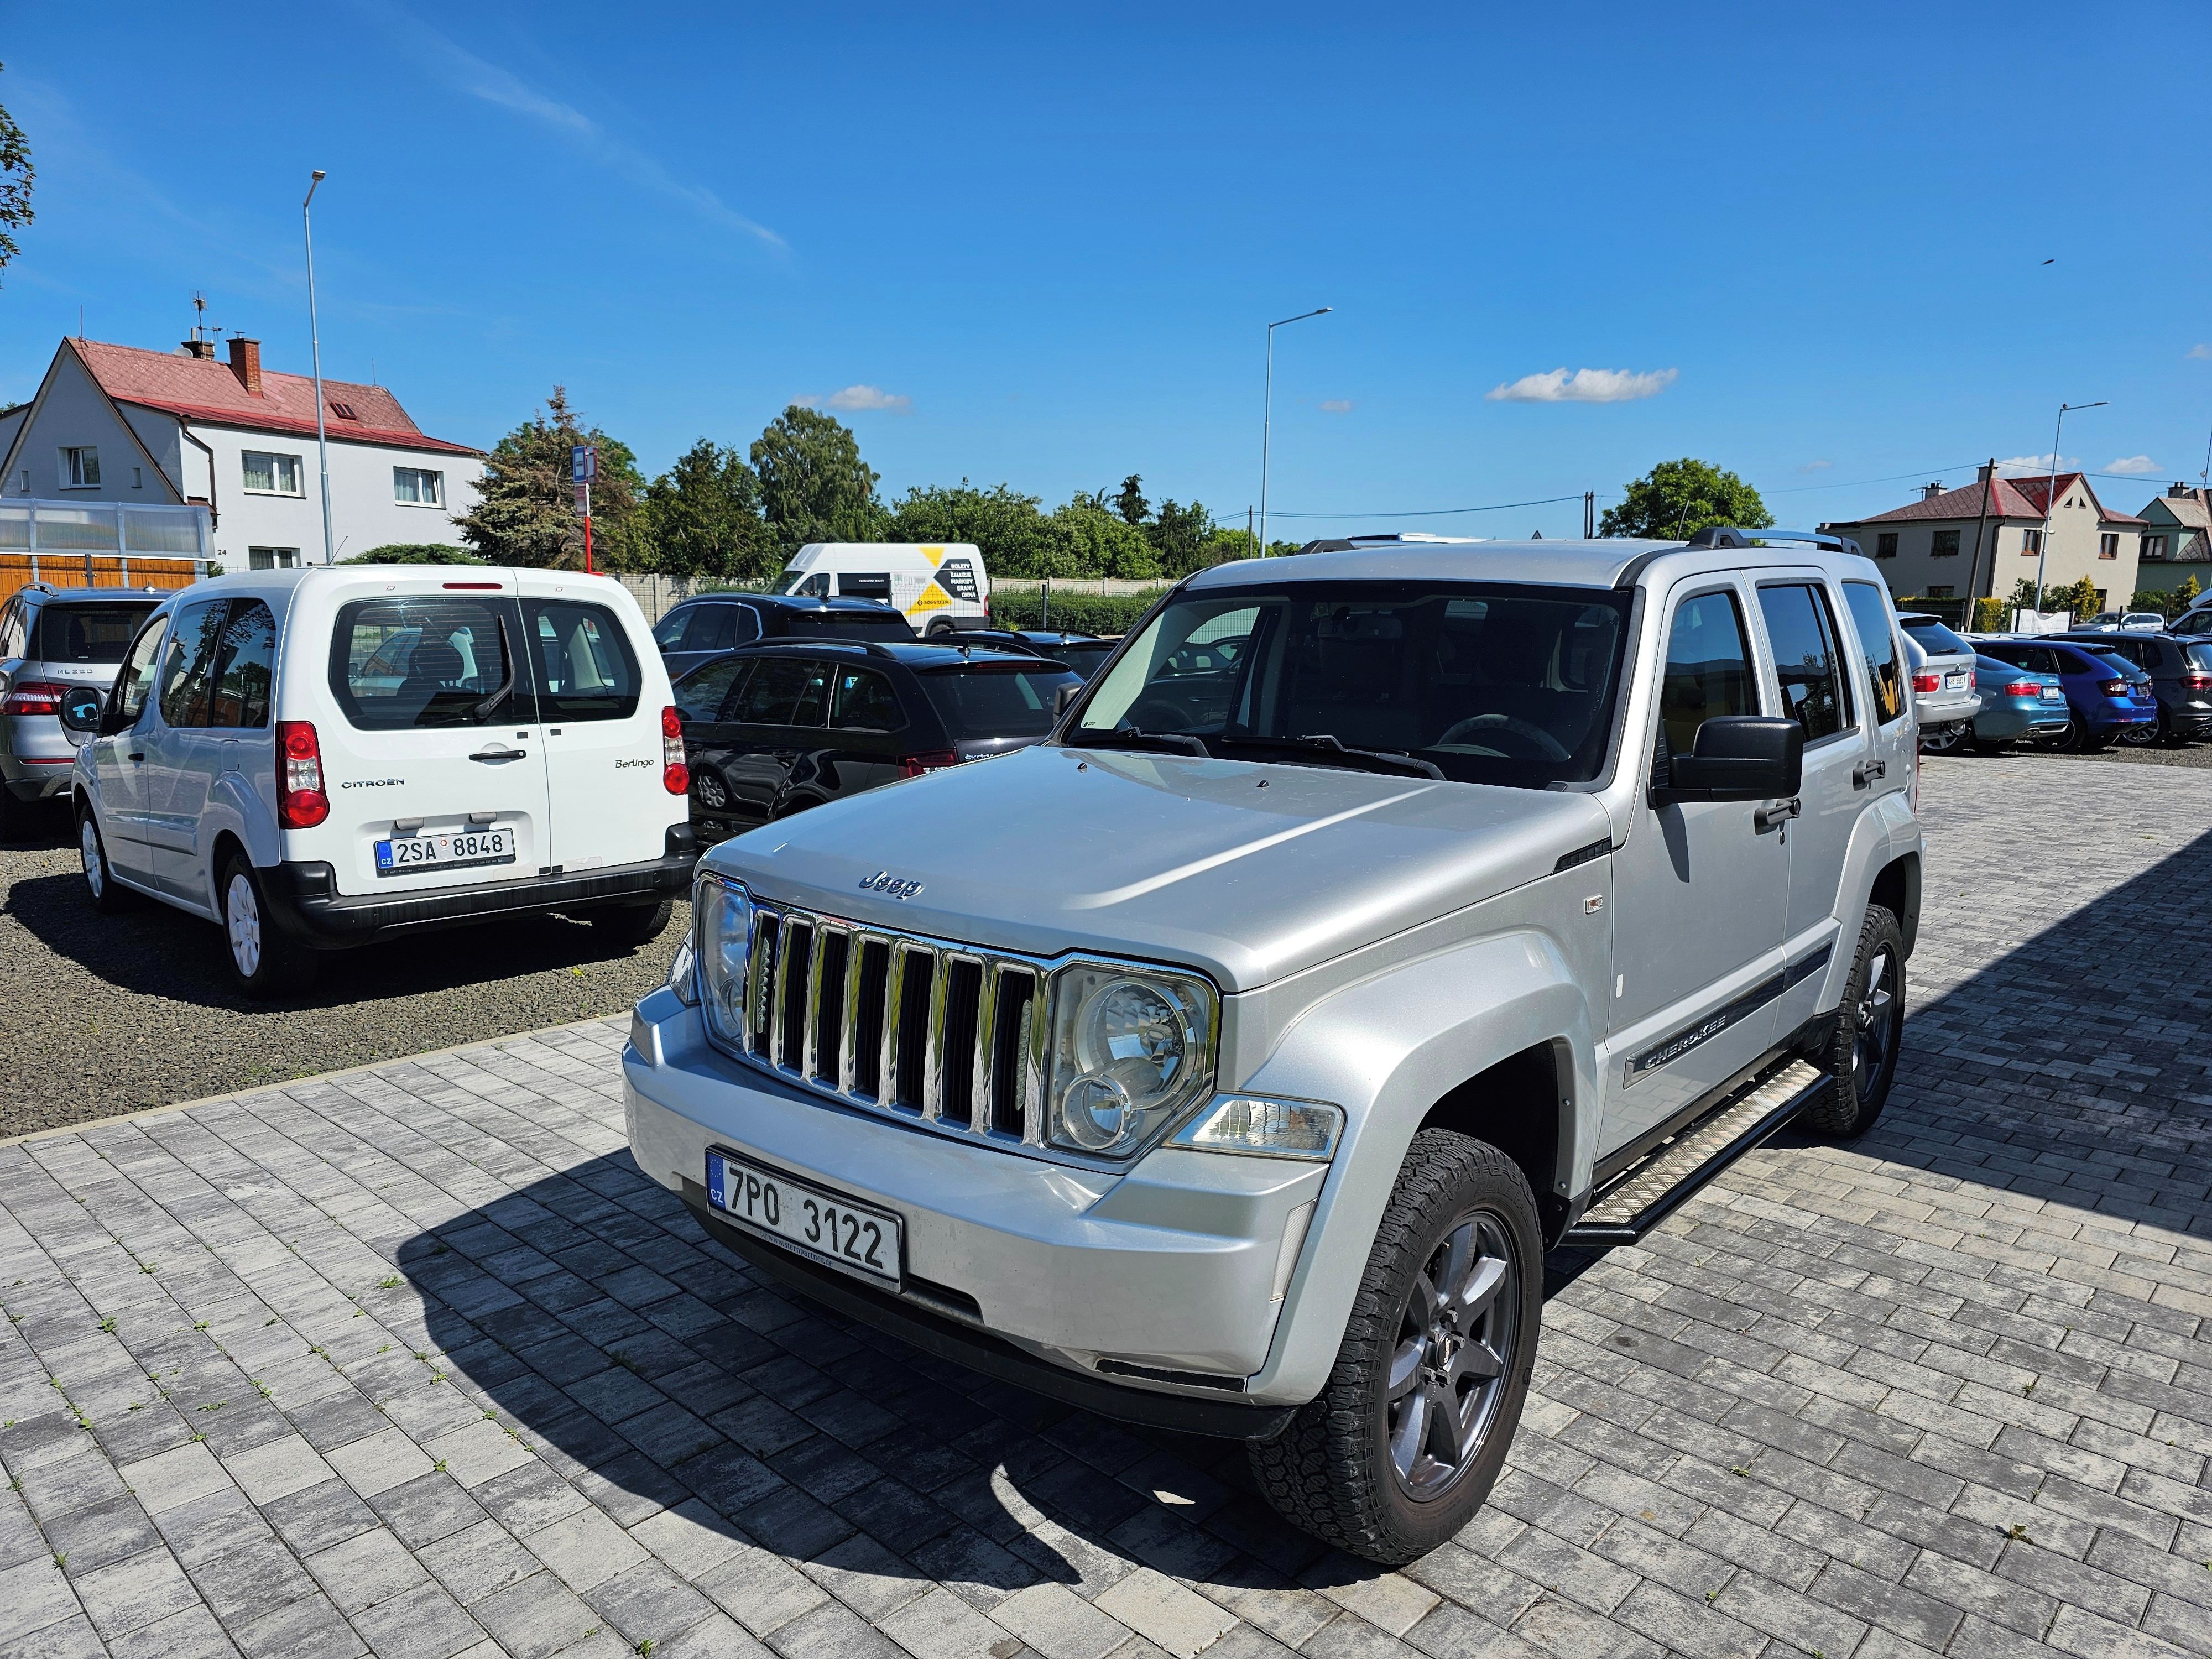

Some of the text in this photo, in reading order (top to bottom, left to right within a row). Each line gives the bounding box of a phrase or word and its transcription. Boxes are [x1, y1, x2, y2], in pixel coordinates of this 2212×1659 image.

[615, 758, 654, 769] Berlingo
[341, 778, 405, 789] CITROËN
[397, 834, 503, 863] 2SA 8848
[858, 870, 925, 901] Jeep
[1644, 1014, 1726, 1070] CHEROKEE
[710, 1188, 724, 1204] CZ
[802, 1199, 883, 1270] 3122
[768, 1234, 834, 1267] www.sternpartner.de
